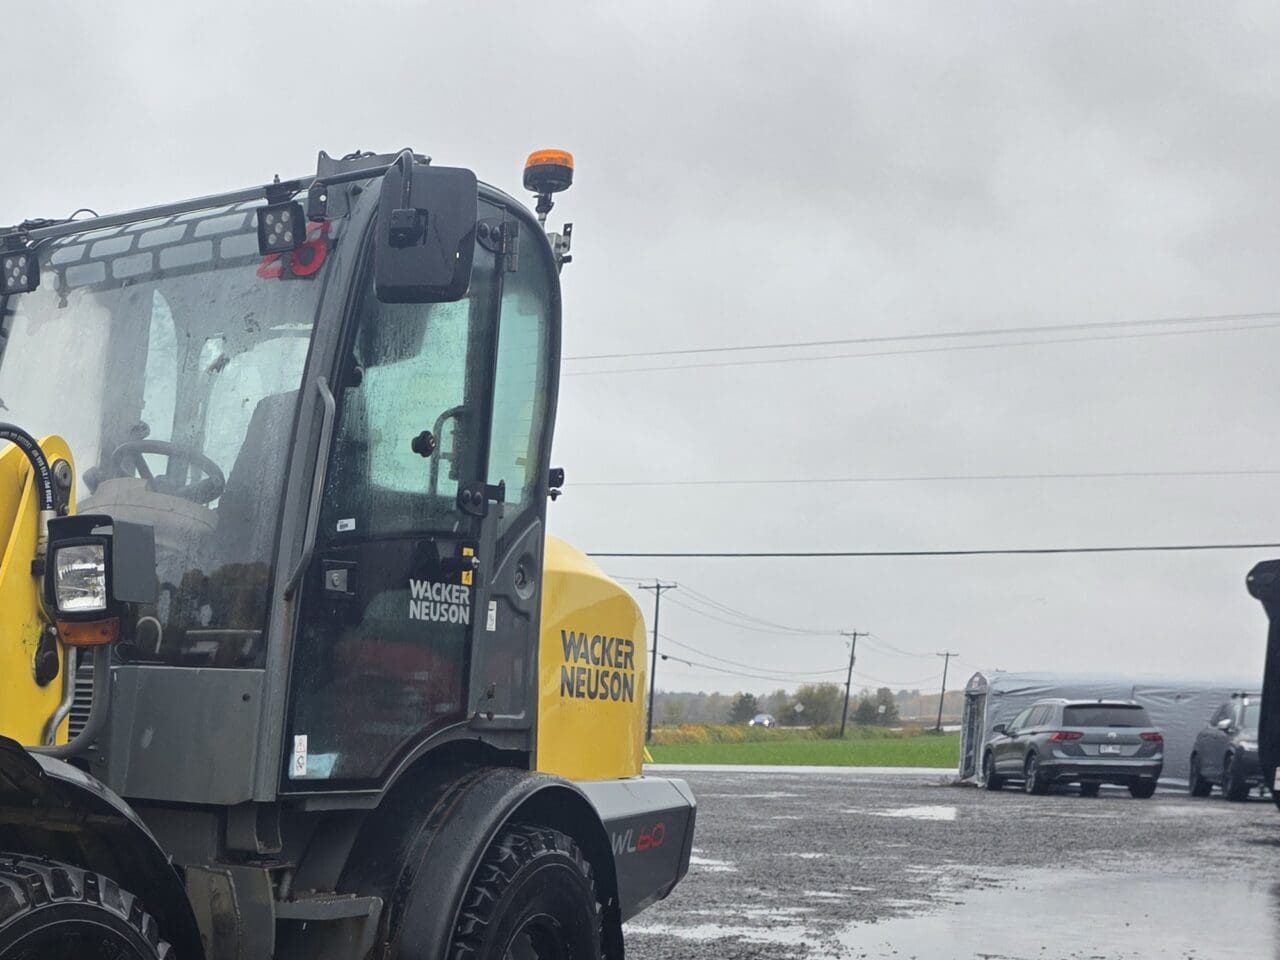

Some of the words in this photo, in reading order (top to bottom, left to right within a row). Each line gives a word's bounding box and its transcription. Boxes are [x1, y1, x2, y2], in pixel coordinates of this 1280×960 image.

[409, 578, 471, 605] WACKER
[409, 599, 470, 625] NEUSON
[560, 629, 635, 671] WACKER
[560, 664, 635, 703] NEUSON
